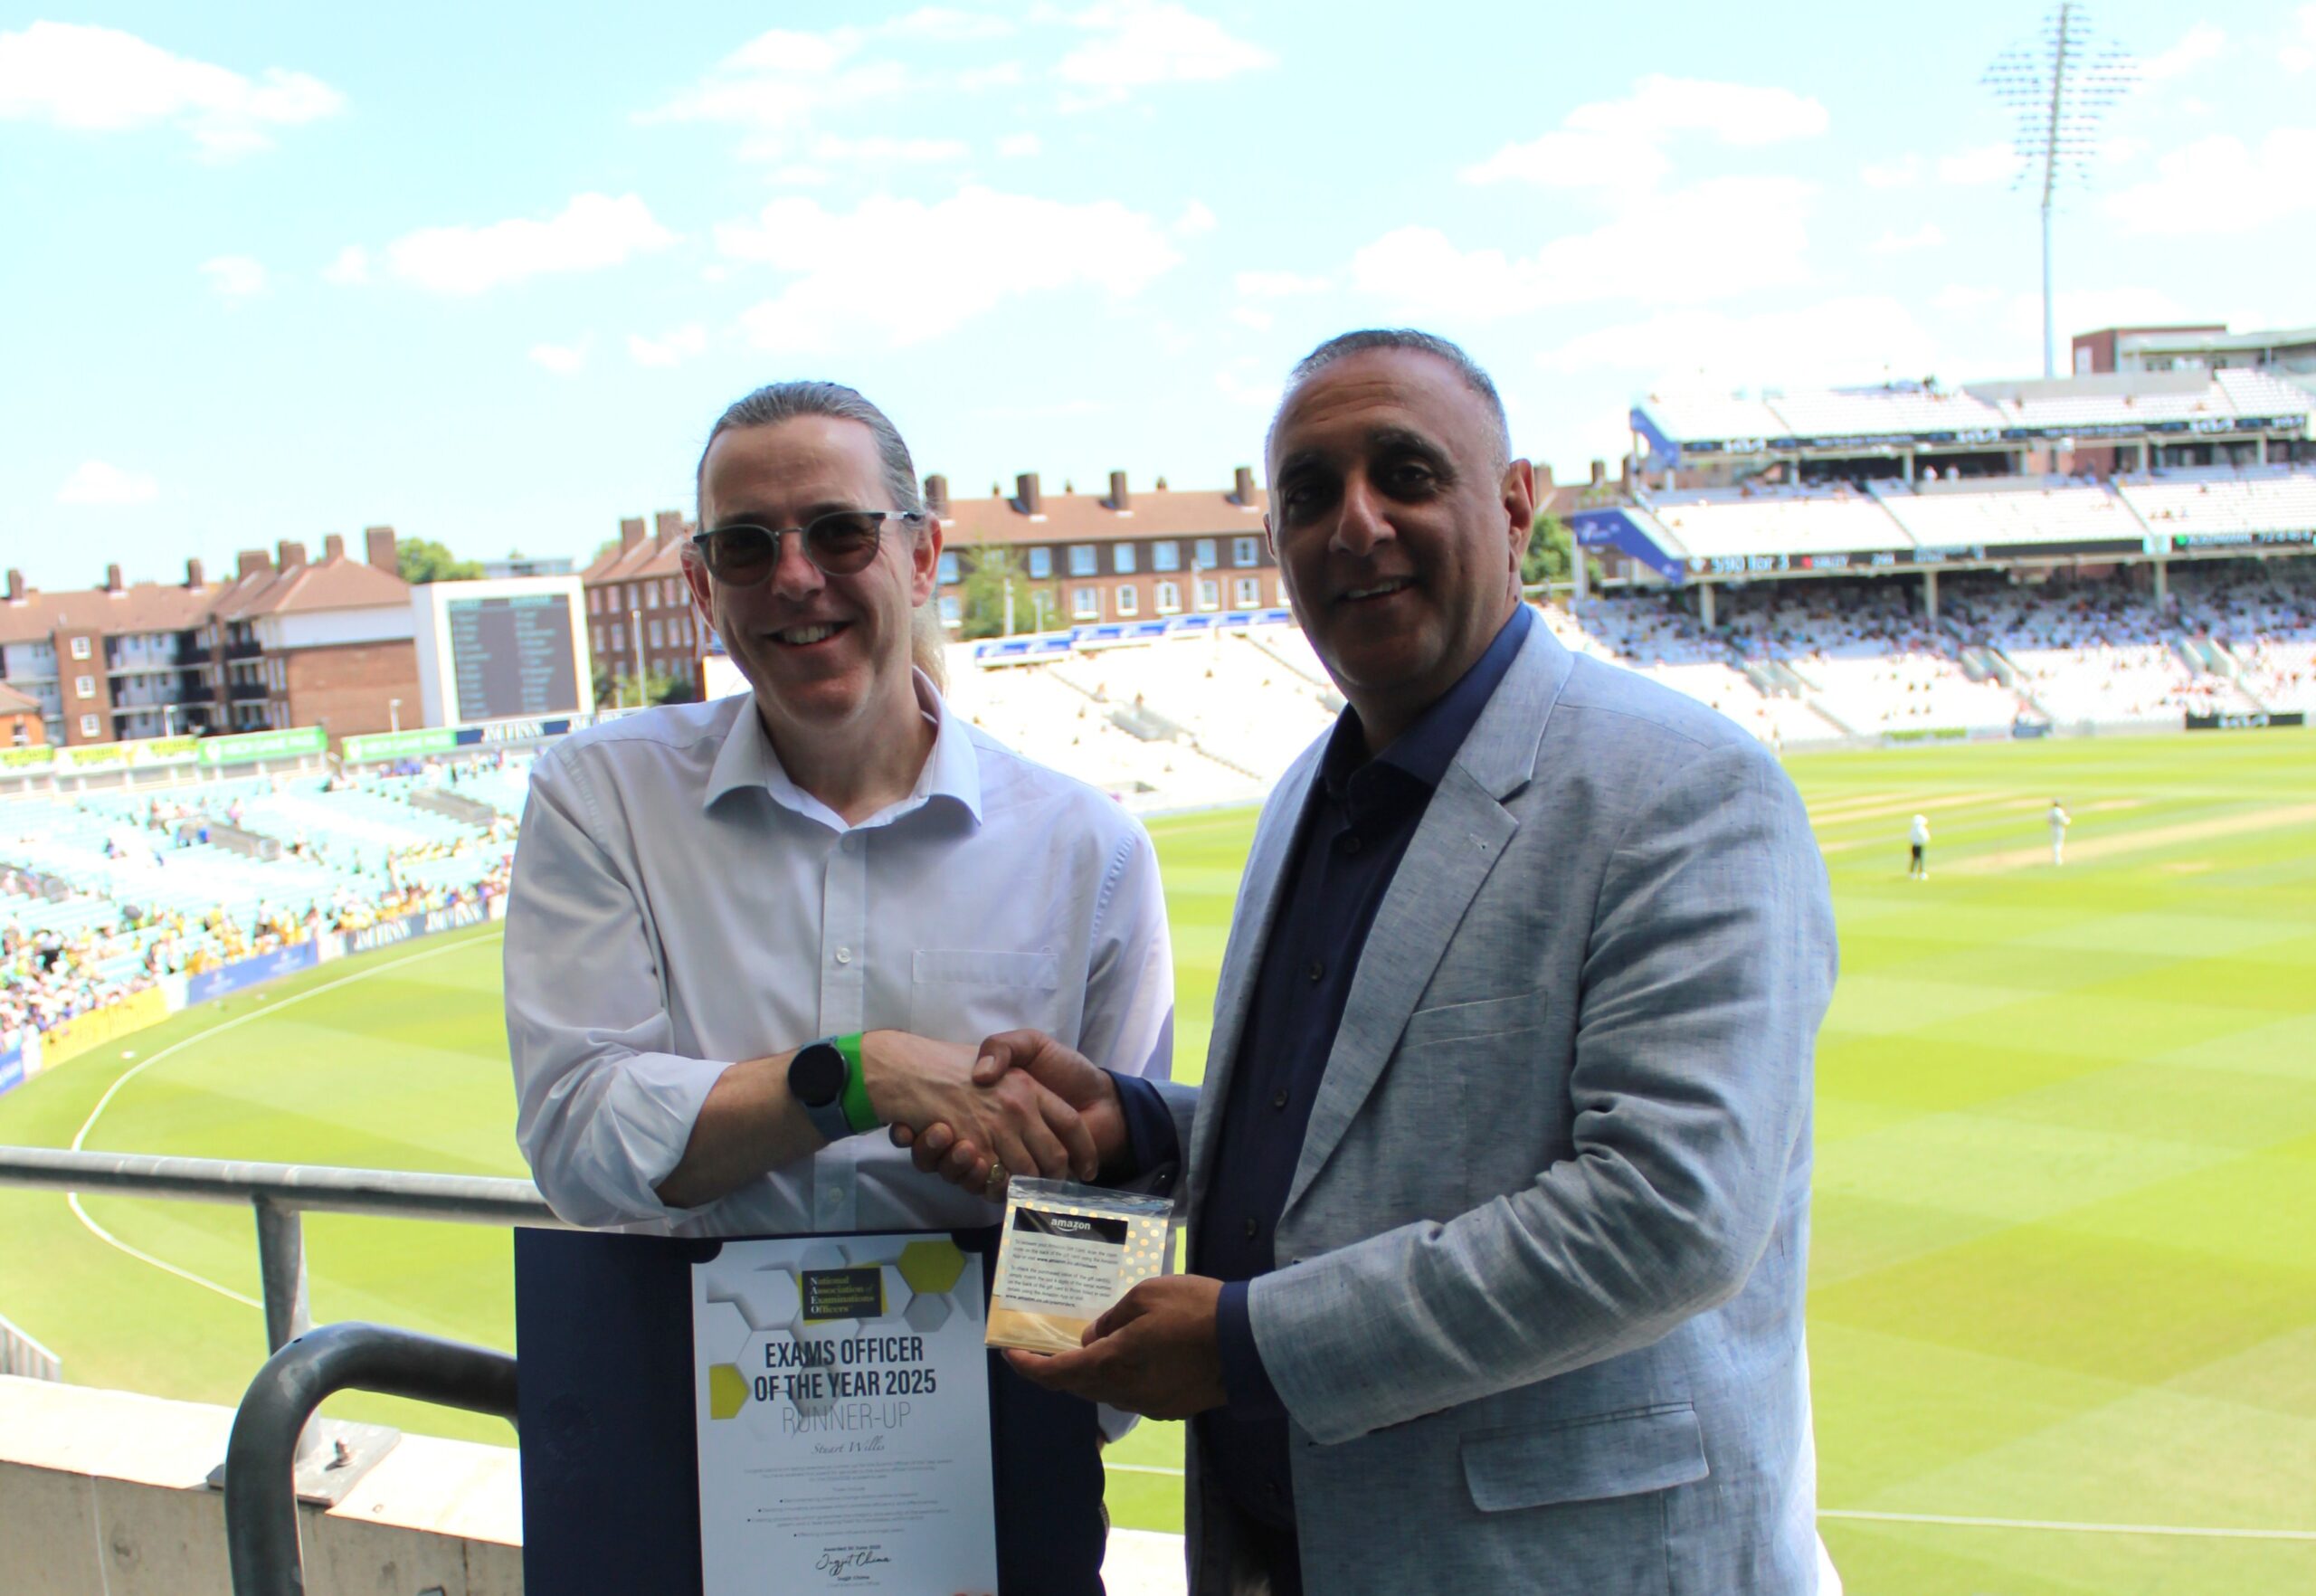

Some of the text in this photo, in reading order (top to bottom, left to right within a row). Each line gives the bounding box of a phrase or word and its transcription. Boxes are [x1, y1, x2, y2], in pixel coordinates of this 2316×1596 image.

[1050, 1218, 1091, 1231] amazon
[810, 1275, 849, 1286] National
[810, 1286, 864, 1295] Association
[811, 1295, 875, 1305] Examinations
[764, 1336, 924, 1368] EXAMS OFFICER
[754, 1369, 936, 1401] OF THE YEAR 2025
[782, 1401, 912, 1434] RUNNER-UP
[811, 1435, 886, 1455] Stuart Willis
